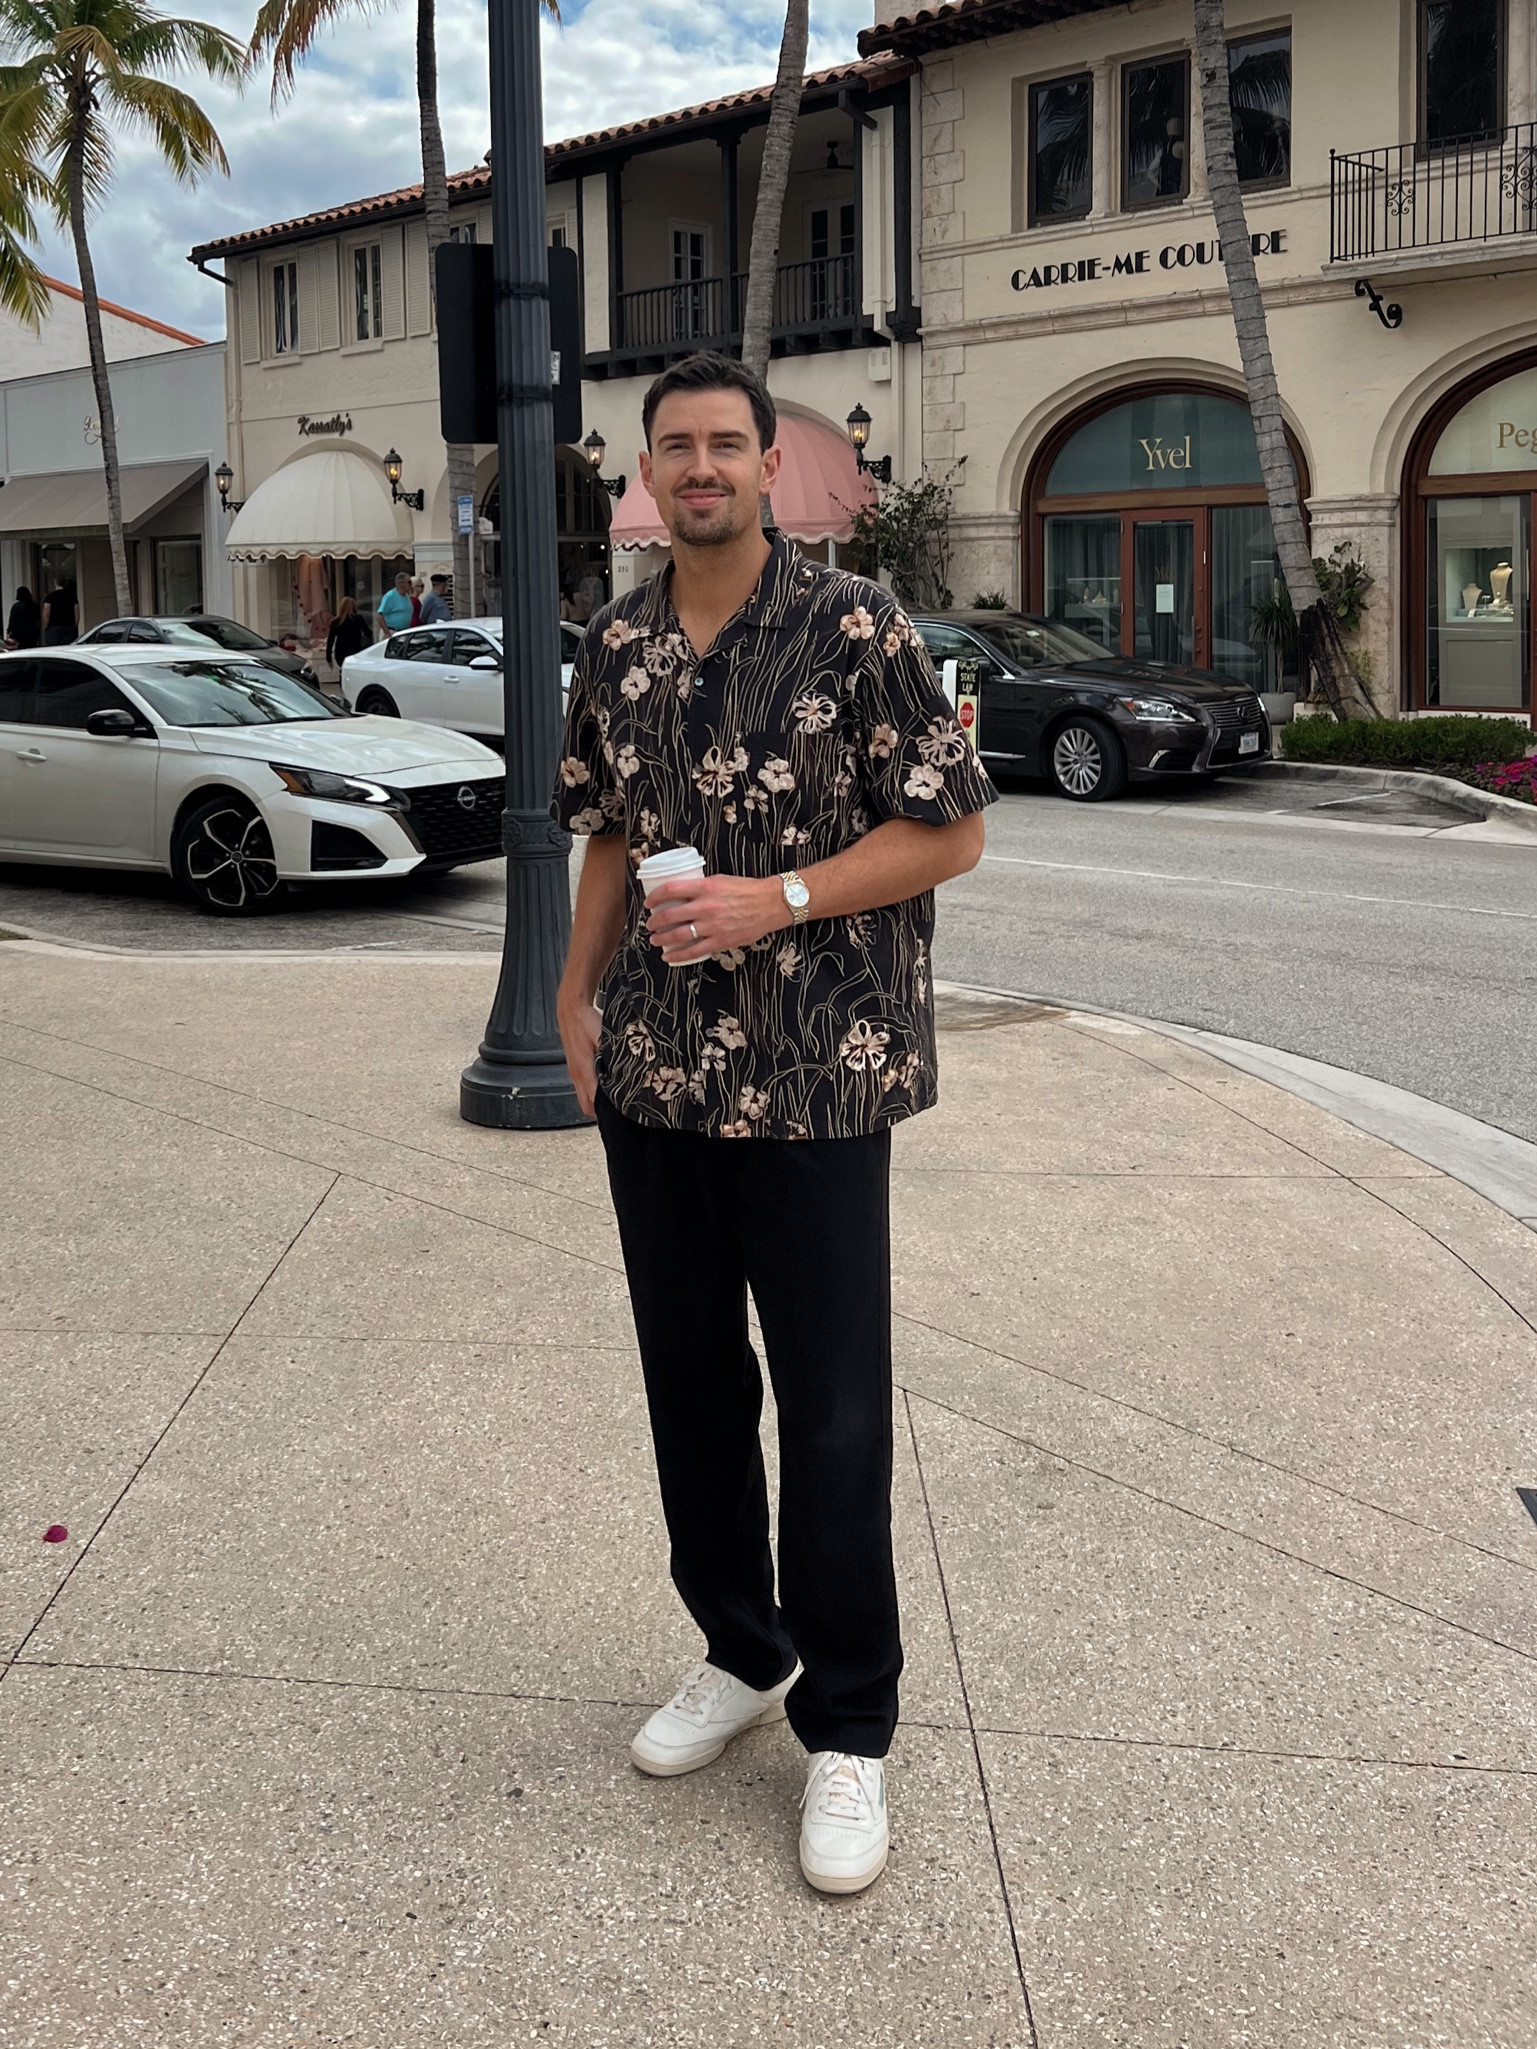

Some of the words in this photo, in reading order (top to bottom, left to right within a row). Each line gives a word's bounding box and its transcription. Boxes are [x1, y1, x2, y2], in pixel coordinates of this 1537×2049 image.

[1011, 250, 1151, 291] CARRIE-ME
[1159, 229, 1288, 270] COURE
[1139, 435, 1192, 471] Yvel
[960, 672, 976, 682] STATE
[960, 709, 974, 720] STOP
